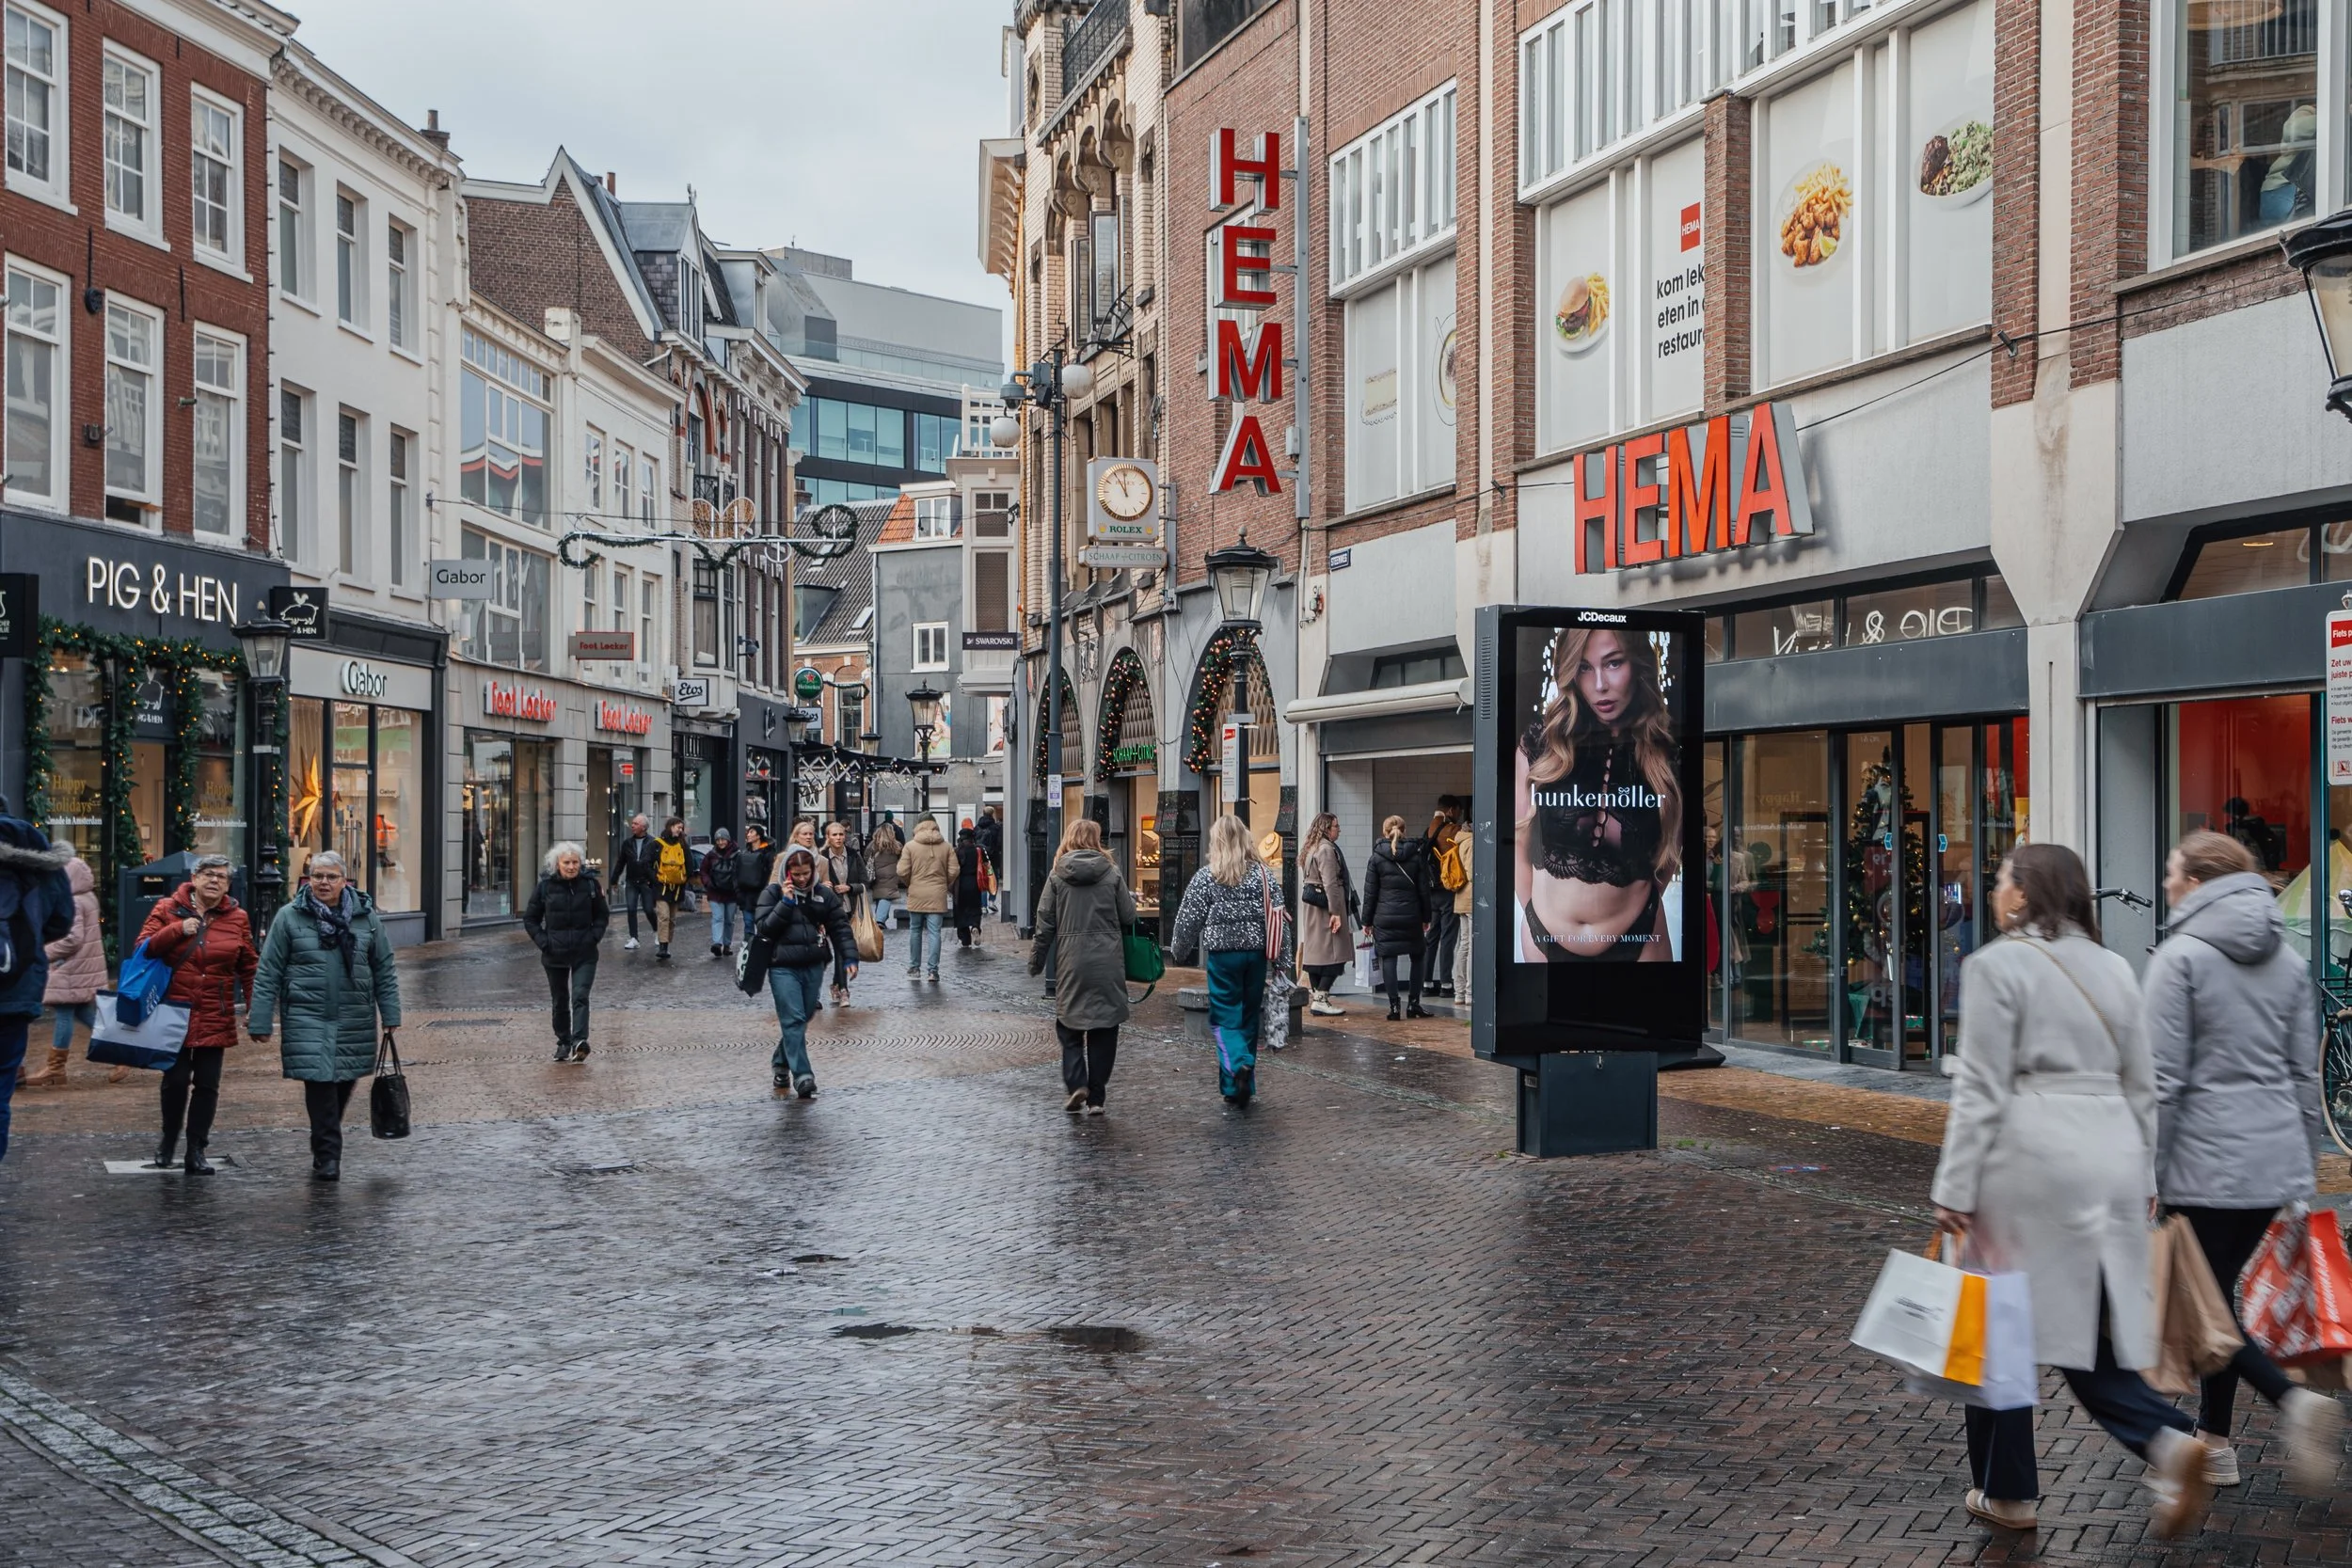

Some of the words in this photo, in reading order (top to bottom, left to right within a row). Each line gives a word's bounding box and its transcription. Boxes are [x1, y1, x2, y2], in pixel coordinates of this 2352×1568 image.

[1682, 218, 1700, 237] HEMA
[1657, 275, 1683, 299] kom
[1209, 127, 1282, 496] HEMA
[1658, 301, 1685, 329] eten
[1688, 294, 1699, 319] in
[1574, 402, 1814, 576] HEMA
[1109, 525, 1142, 534] ROLEX
[437, 569, 486, 584] Gabor
[87, 556, 141, 610] PIG
[151, 563, 170, 614] &
[179, 572, 237, 626] HEN
[1577, 611, 1627, 623] JCDecaux
[976, 637, 1013, 645] SWAROVSKI
[2333, 629, 2347, 639] Fiets
[580, 641, 597, 650] Foot
[600, 641, 628, 650] Locker
[2331, 659, 2341, 668] Zet
[345, 660, 388, 697] Gabor
[2330, 670, 2347, 681] juiste
[678, 682, 704, 696] Etos
[491, 680, 516, 715] Foot
[520, 688, 557, 722] Locker
[602, 700, 621, 730] Foot
[624, 706, 653, 736] Locker
[2331, 716, 2346, 724] Fiets
[53, 775, 87, 796] Happy
[66, 816, 72, 825] in
[72, 816, 103, 825] Amsterdam
[1567, 934, 1587, 942] FOR
[1588, 934, 1618, 942] EVERY
[1620, 934, 1661, 942] MOMENT
